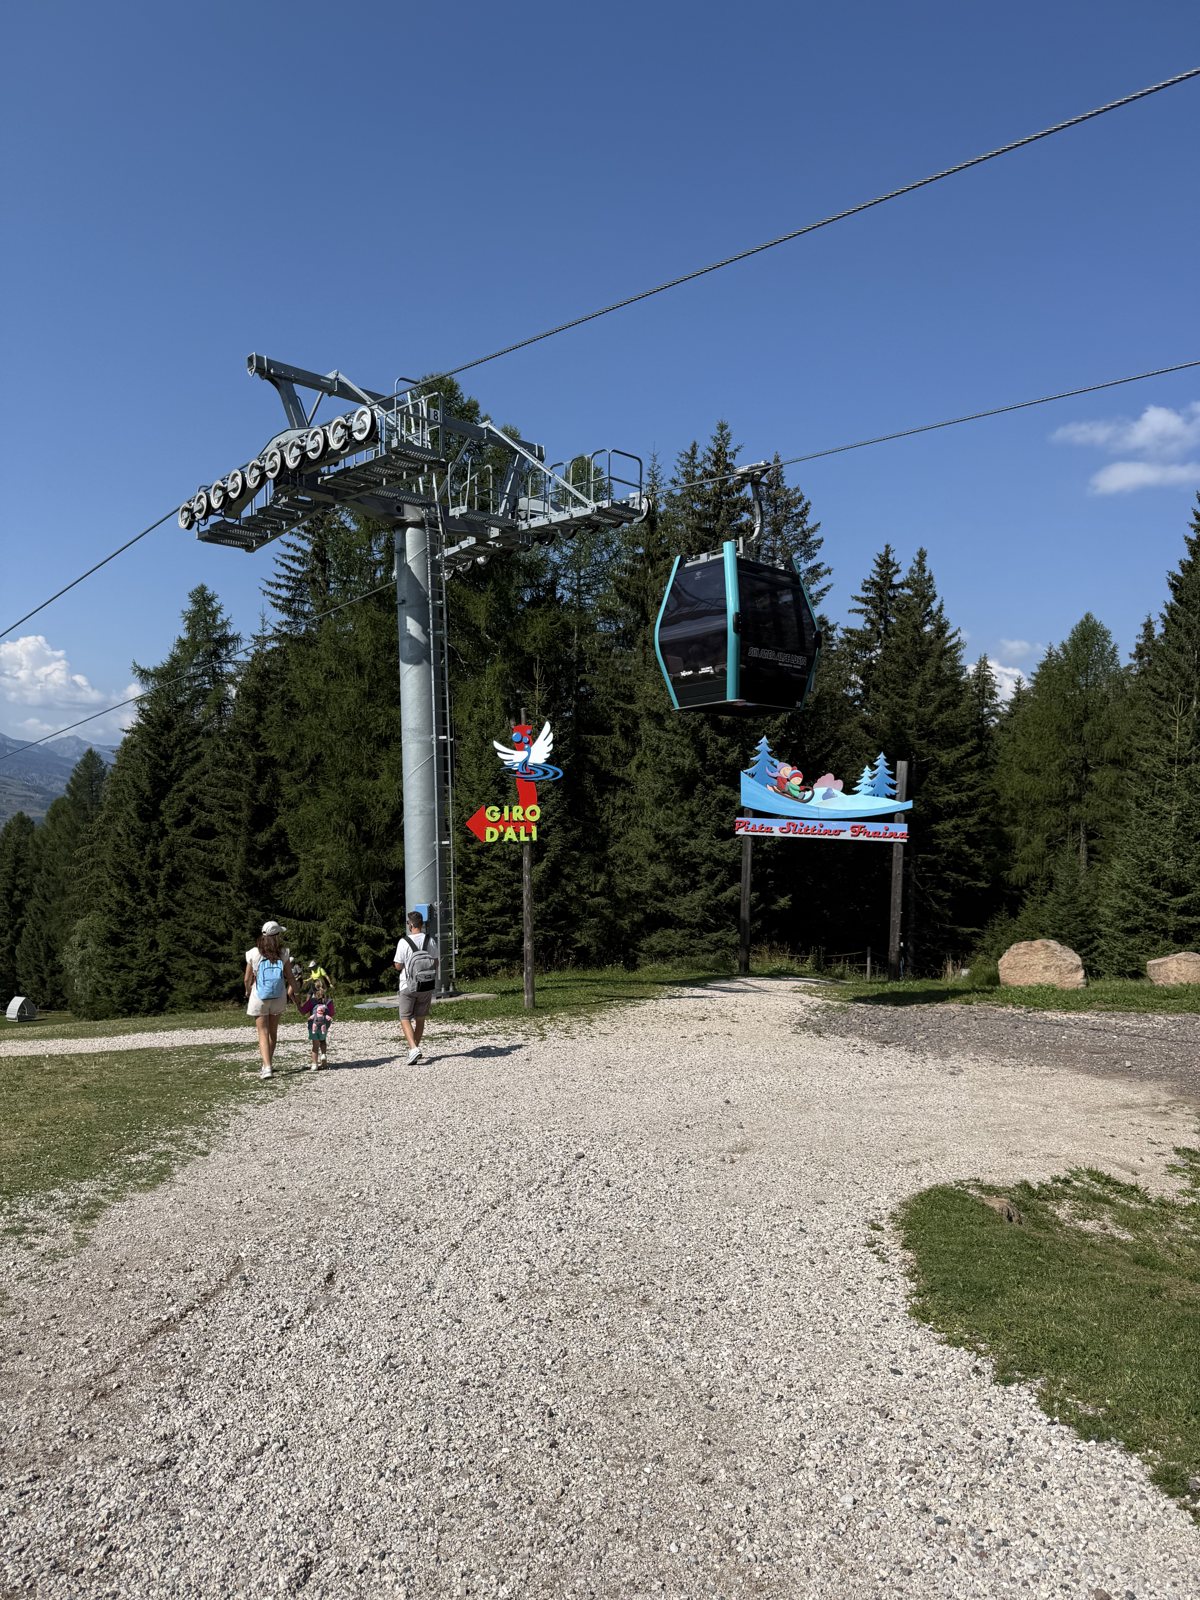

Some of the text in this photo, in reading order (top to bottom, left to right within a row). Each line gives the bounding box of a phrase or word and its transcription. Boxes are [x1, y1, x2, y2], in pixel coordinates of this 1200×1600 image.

[433, 410, 439, 421] 8
[485, 804, 541, 822] GIRO
[485, 825, 537, 842] D'ALI
[734, 819, 910, 840] Pista Slittino Fraina
